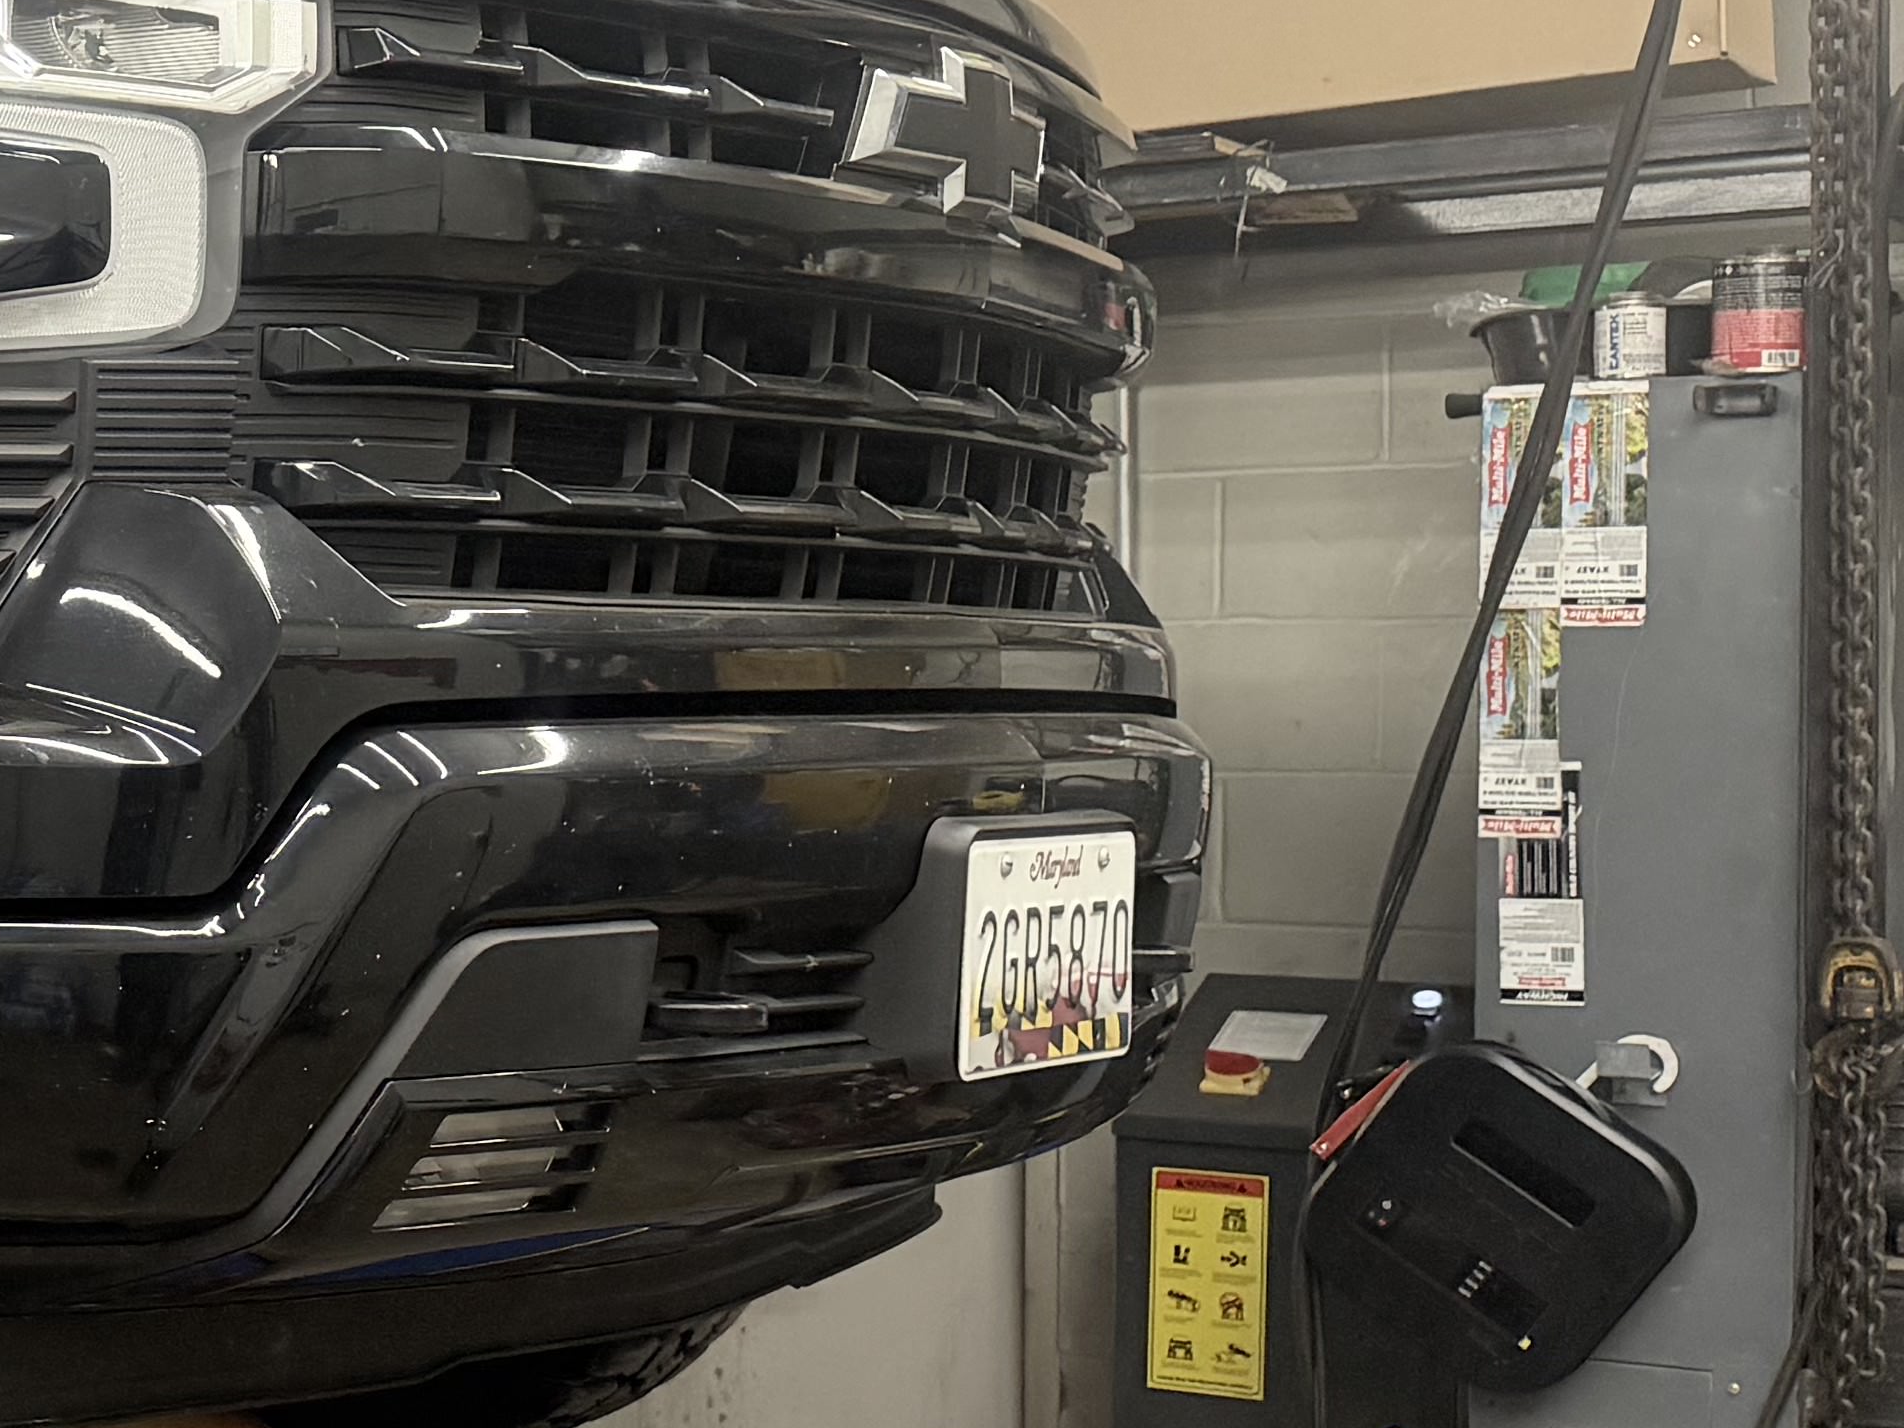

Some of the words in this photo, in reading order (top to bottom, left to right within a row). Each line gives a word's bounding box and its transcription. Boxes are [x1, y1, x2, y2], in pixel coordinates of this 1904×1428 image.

[1572, 426, 1588, 500] Multi-Mile
[1490, 639, 1504, 713] Multi-Mile
[1029, 844, 1085, 890] Maryland
[976, 898, 1130, 1038] 2GR5870
